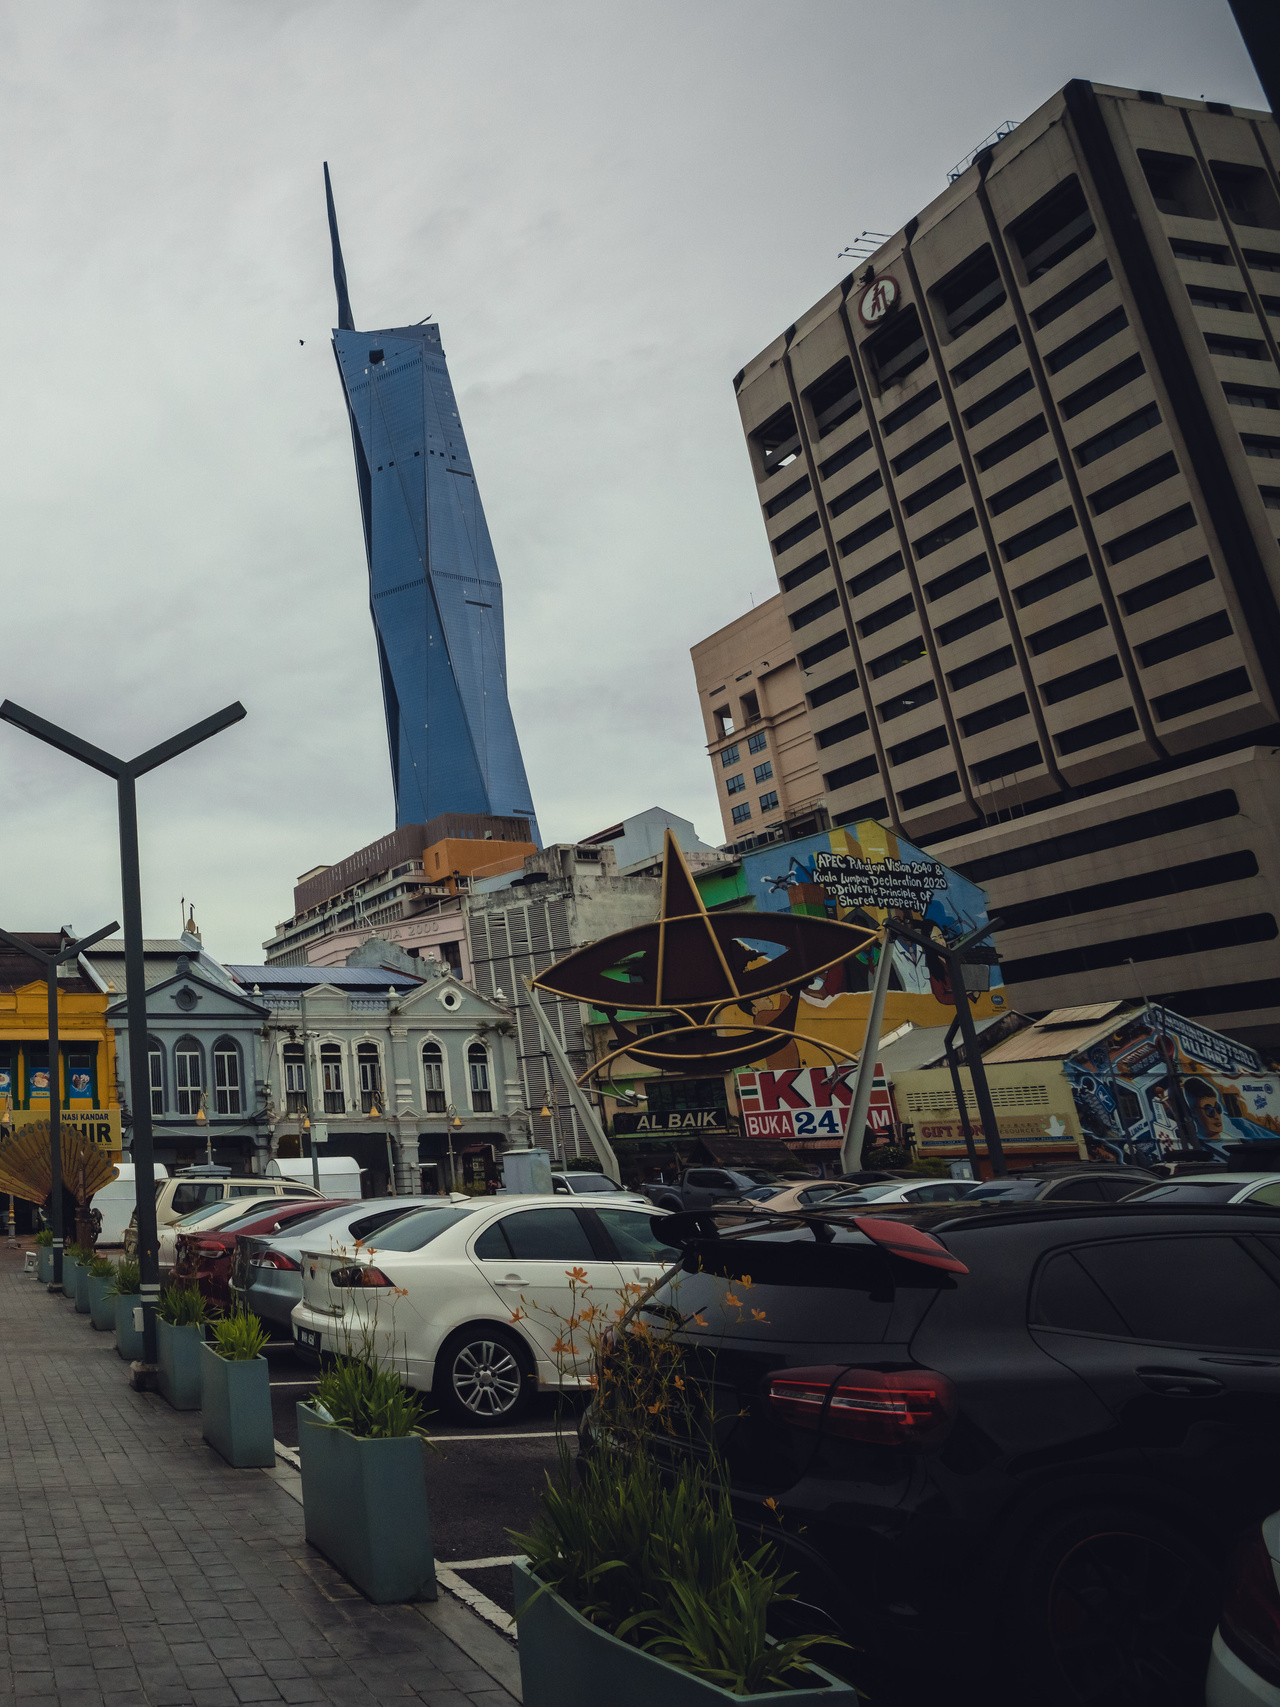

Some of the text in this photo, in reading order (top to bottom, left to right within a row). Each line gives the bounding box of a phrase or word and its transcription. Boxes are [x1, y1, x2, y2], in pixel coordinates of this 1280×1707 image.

[818, 854, 846, 869] APEC
[846, 856, 886, 875] Putrajaya
[911, 861, 932, 875] 2040
[934, 864, 944, 876] &
[813, 870, 947, 889] Kuala Lumpur Declaration 2020
[839, 894, 875, 907] Shared
[878, 887, 918, 900] Principle
[408, 922, 438, 937] 2000
[758, 1065, 858, 1110] KK
[80, 1113, 109, 1121] KANDAR
[637, 1111, 717, 1129] AL BAIK
[747, 1115, 792, 1135] BUKA
[795, 1110, 839, 1135] 24
[921, 1125, 953, 1139] GIFT
[999, 1127, 1041, 1135] ESOURCES
